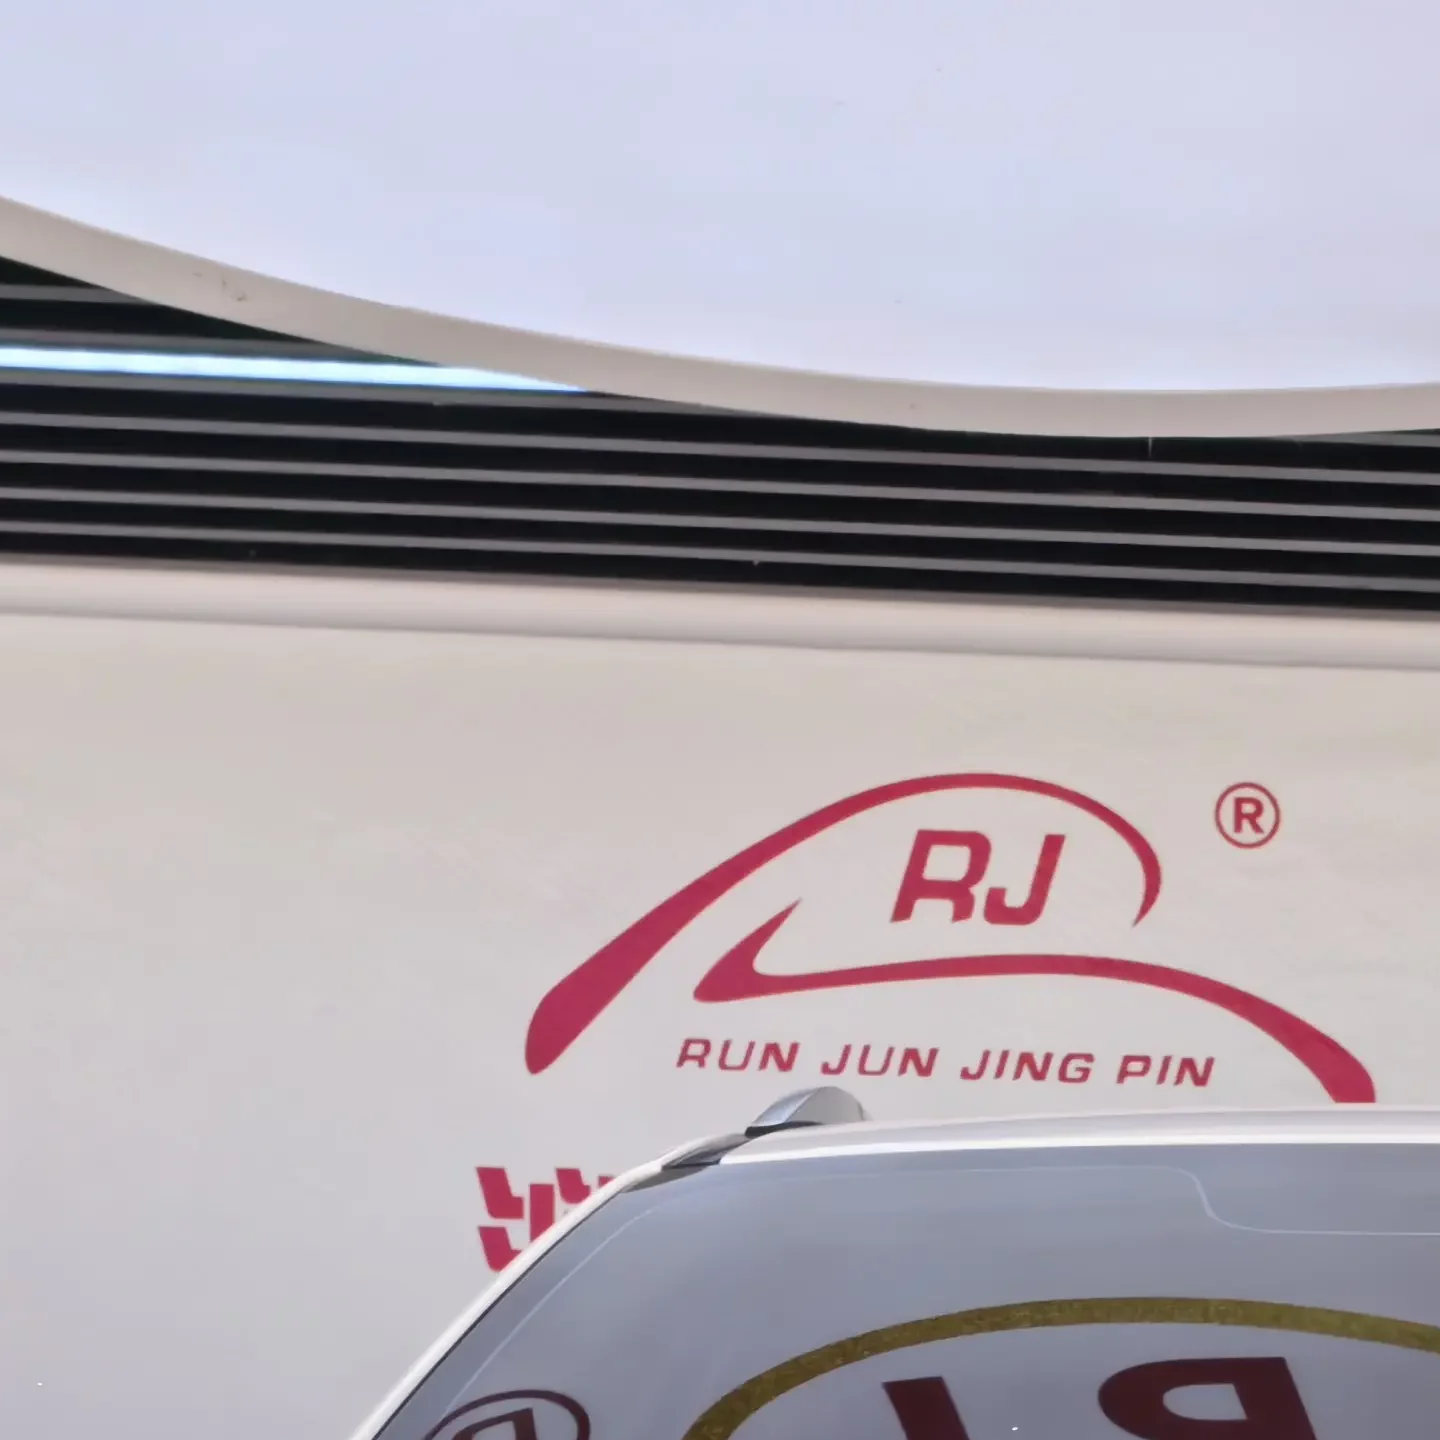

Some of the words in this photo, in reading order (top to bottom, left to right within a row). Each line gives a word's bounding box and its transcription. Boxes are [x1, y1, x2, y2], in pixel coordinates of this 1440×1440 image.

[892, 830, 1065, 925] RJ
[677, 1038, 799, 1073] RUN
[821, 1044, 937, 1078] JUN
[960, 1050, 1094, 1084] JING
[1117, 1055, 1215, 1087] PIN
